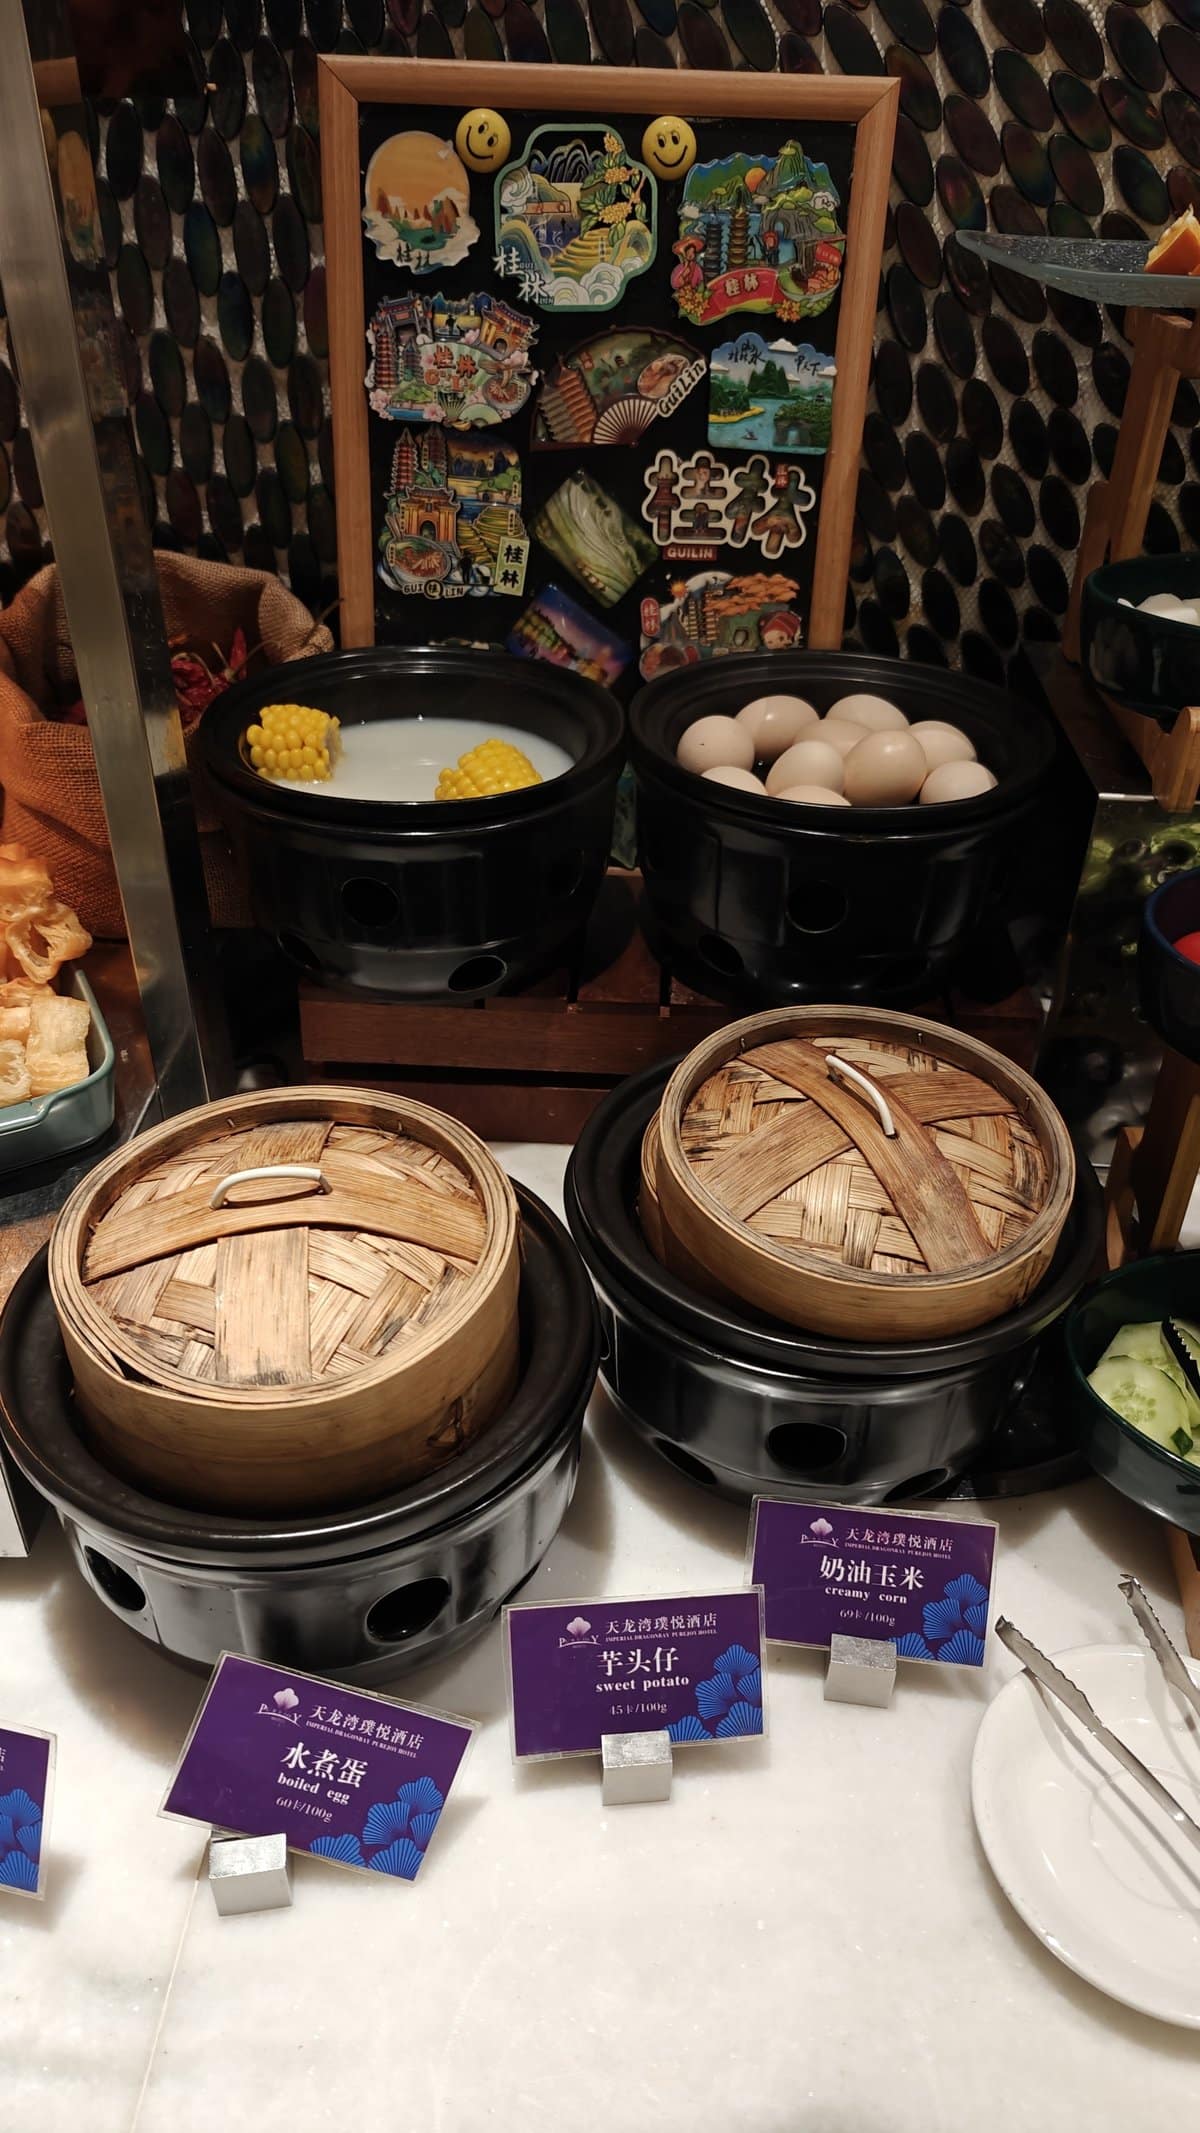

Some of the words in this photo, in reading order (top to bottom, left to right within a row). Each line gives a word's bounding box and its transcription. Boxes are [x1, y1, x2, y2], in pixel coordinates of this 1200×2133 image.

[492, 246, 547, 303] 桂林
[724, 273, 759, 296] 桂林
[433, 344, 478, 377] 桂林
[645, 452, 813, 556] 桂林
[500, 544, 524, 588] 桂林
[667, 547, 713, 558] GUILIN
[403, 584, 423, 594] GUI
[445, 586, 464, 598] LIN
[845, 1527, 954, 1552] 天龙湾璞悦酒店
[820, 1555, 925, 1590] 奶油玉米
[825, 1585, 870, 1602] creamy
[879, 1591, 908, 1604] corn
[605, 1612, 717, 1635] 天龙湾璞悦酒店
[596, 1646, 680, 1677] 芋头仔
[596, 1679, 636, 1693] sweet
[643, 1675, 690, 1692] potato
[308, 1704, 425, 1751] 天龙湾璞悦酒店
[280, 1741, 369, 1788] 水煮蛋
[278, 1772, 320, 1795] boiled
[326, 1788, 350, 1806] egg
[276, 1796, 333, 1822] 60卡/100g
